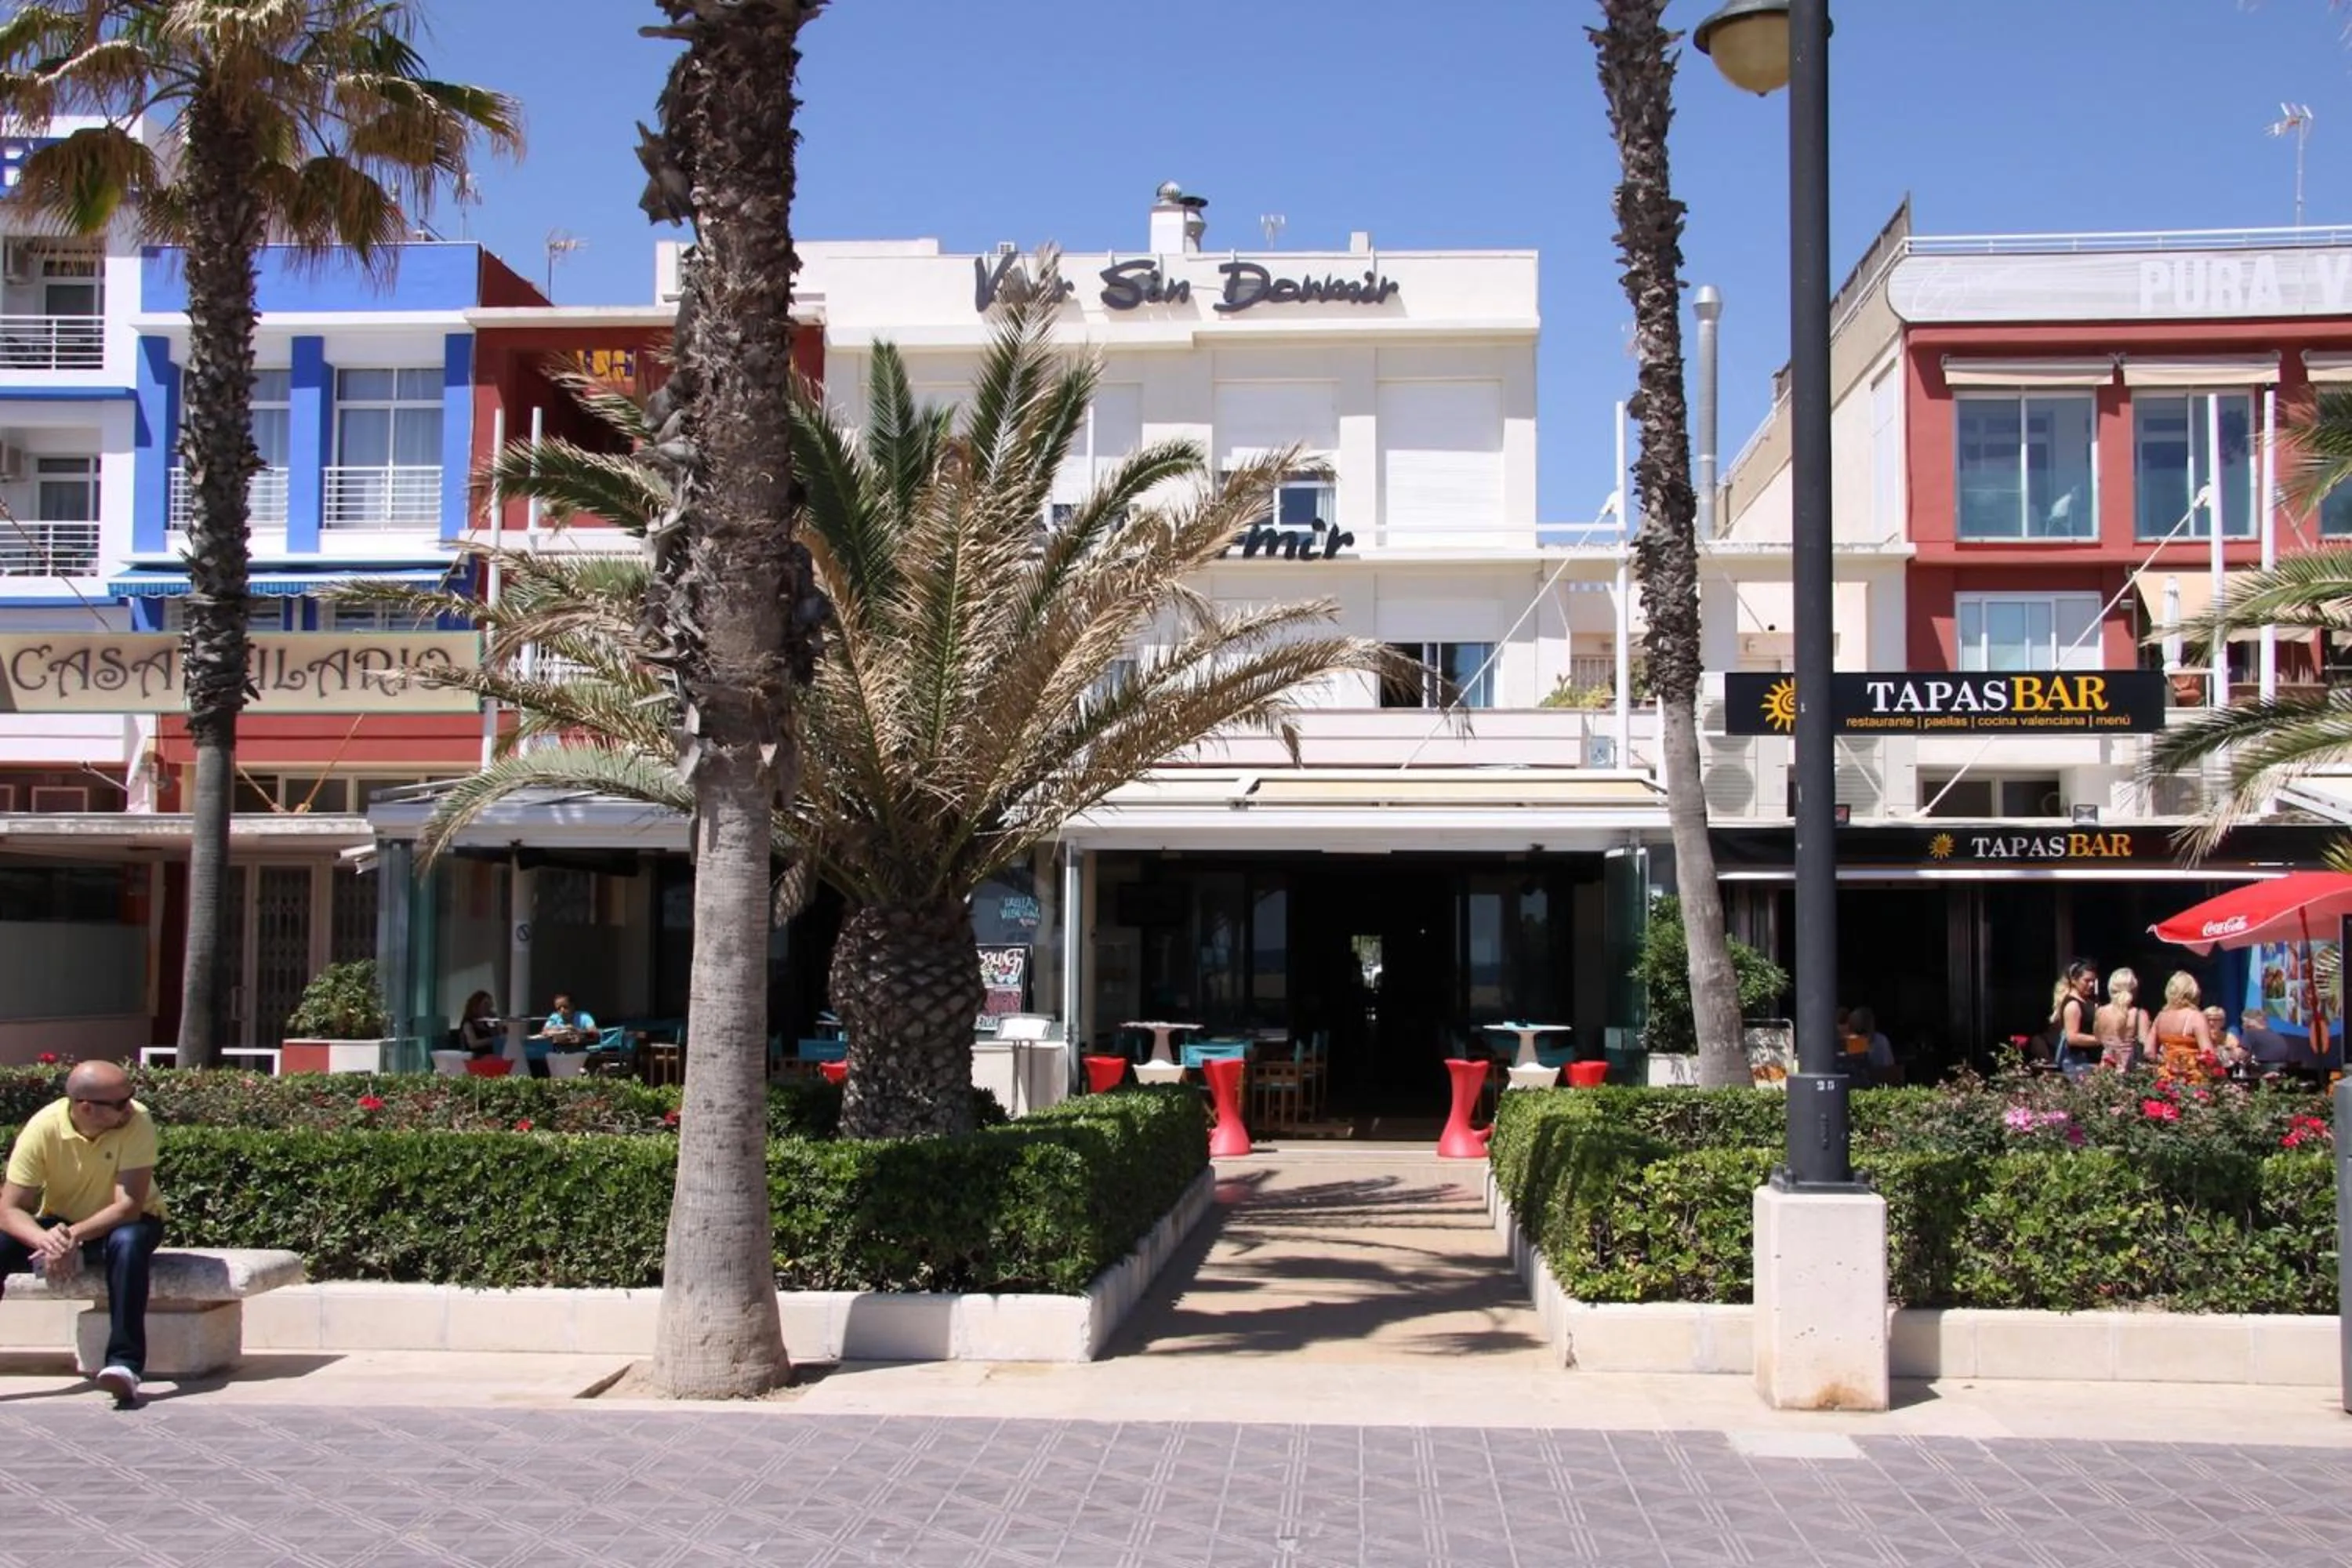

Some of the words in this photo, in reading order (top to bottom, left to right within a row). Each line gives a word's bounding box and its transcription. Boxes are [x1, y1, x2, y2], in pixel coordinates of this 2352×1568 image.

[1100, 260, 1190, 310] Sin
[1213, 263, 1399, 312] Dormir
[2139, 255, 2282, 314] PURA
[11, 644, 173, 699] CASA
[248, 647, 452, 698] ILARIO
[1846, 716, 1915, 728] restaurante
[1924, 715, 1968, 730] paellas
[1977, 714, 2017, 727] cocina
[2020, 714, 2085, 727] valenciana
[2095, 713, 2131, 726] menú
